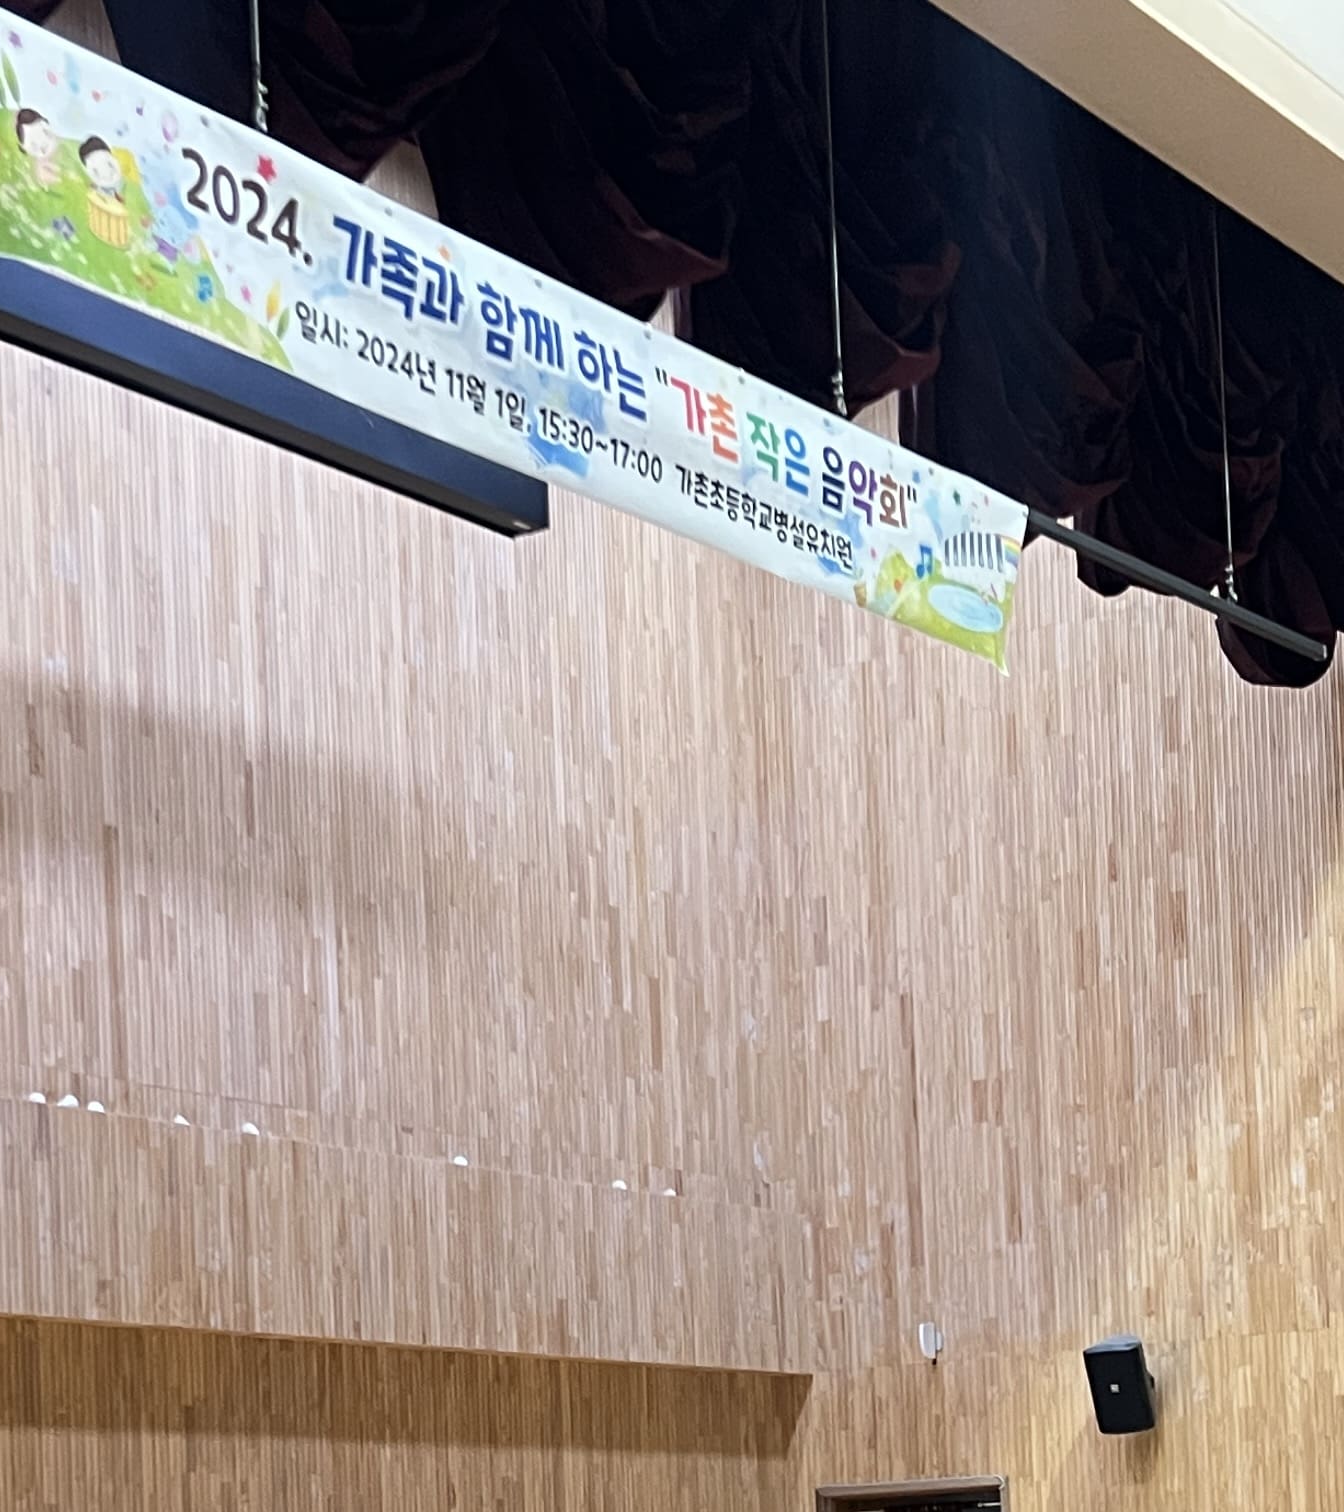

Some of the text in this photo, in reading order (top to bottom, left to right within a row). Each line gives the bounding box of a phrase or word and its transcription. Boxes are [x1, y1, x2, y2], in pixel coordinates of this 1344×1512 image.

[181, 148, 313, 266] 2024.
[333, 214, 465, 323] 가족과
[476, 280, 565, 371] 함께
[574, 329, 647, 421] 하는
[746, 411, 811, 496] 작은
[296, 301, 348, 350] 일시:
[356, 328, 437, 396] 2024년
[445, 368, 487, 416] 11월
[539, 407, 663, 483] 15:30~17:00
[675, 463, 853, 570] 가촌초등학교병설유치원
